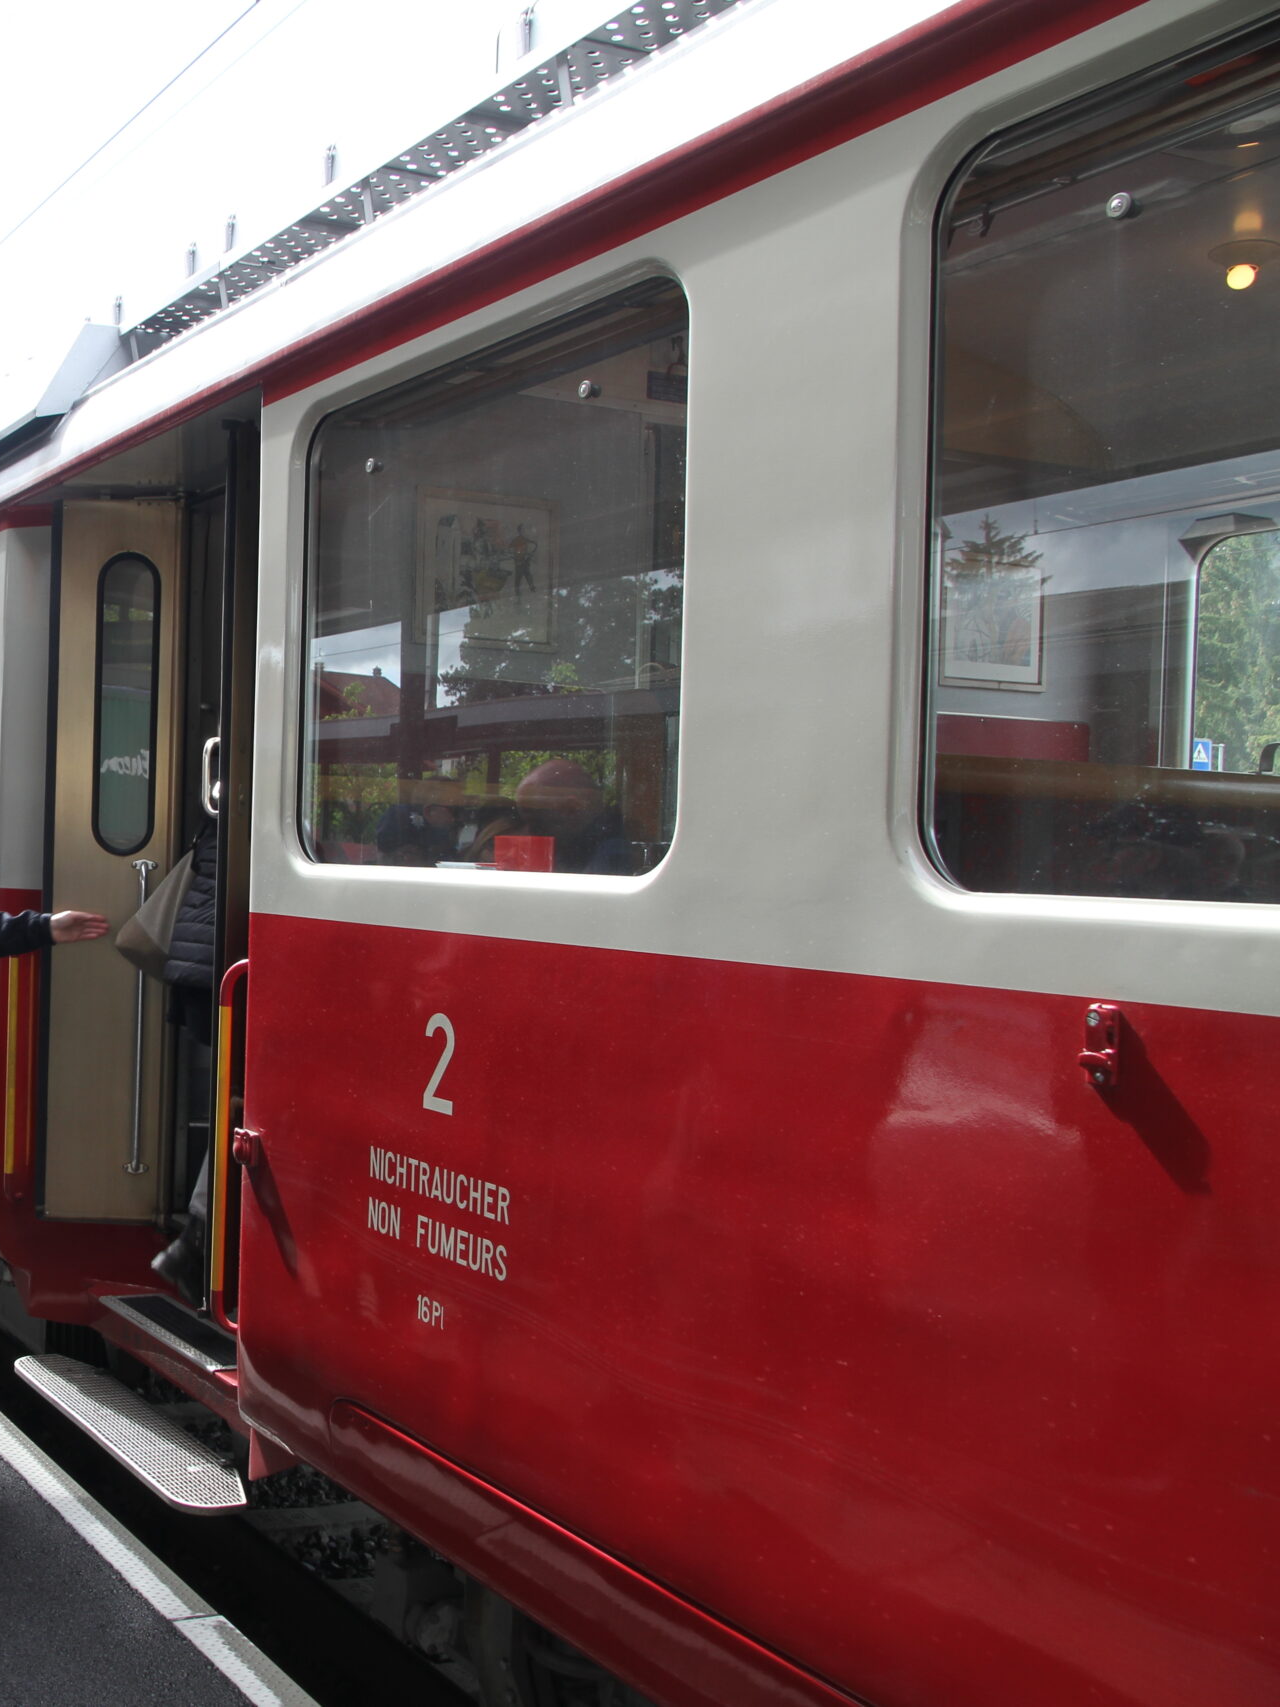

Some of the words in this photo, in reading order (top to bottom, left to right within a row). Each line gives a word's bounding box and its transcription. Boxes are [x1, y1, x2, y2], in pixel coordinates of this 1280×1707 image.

[422, 1012, 455, 1116] 2
[370, 1145, 510, 1226] NICHTRAUCHER
[368, 1196, 401, 1240] NON
[416, 1214, 507, 1282] FUMEURS
